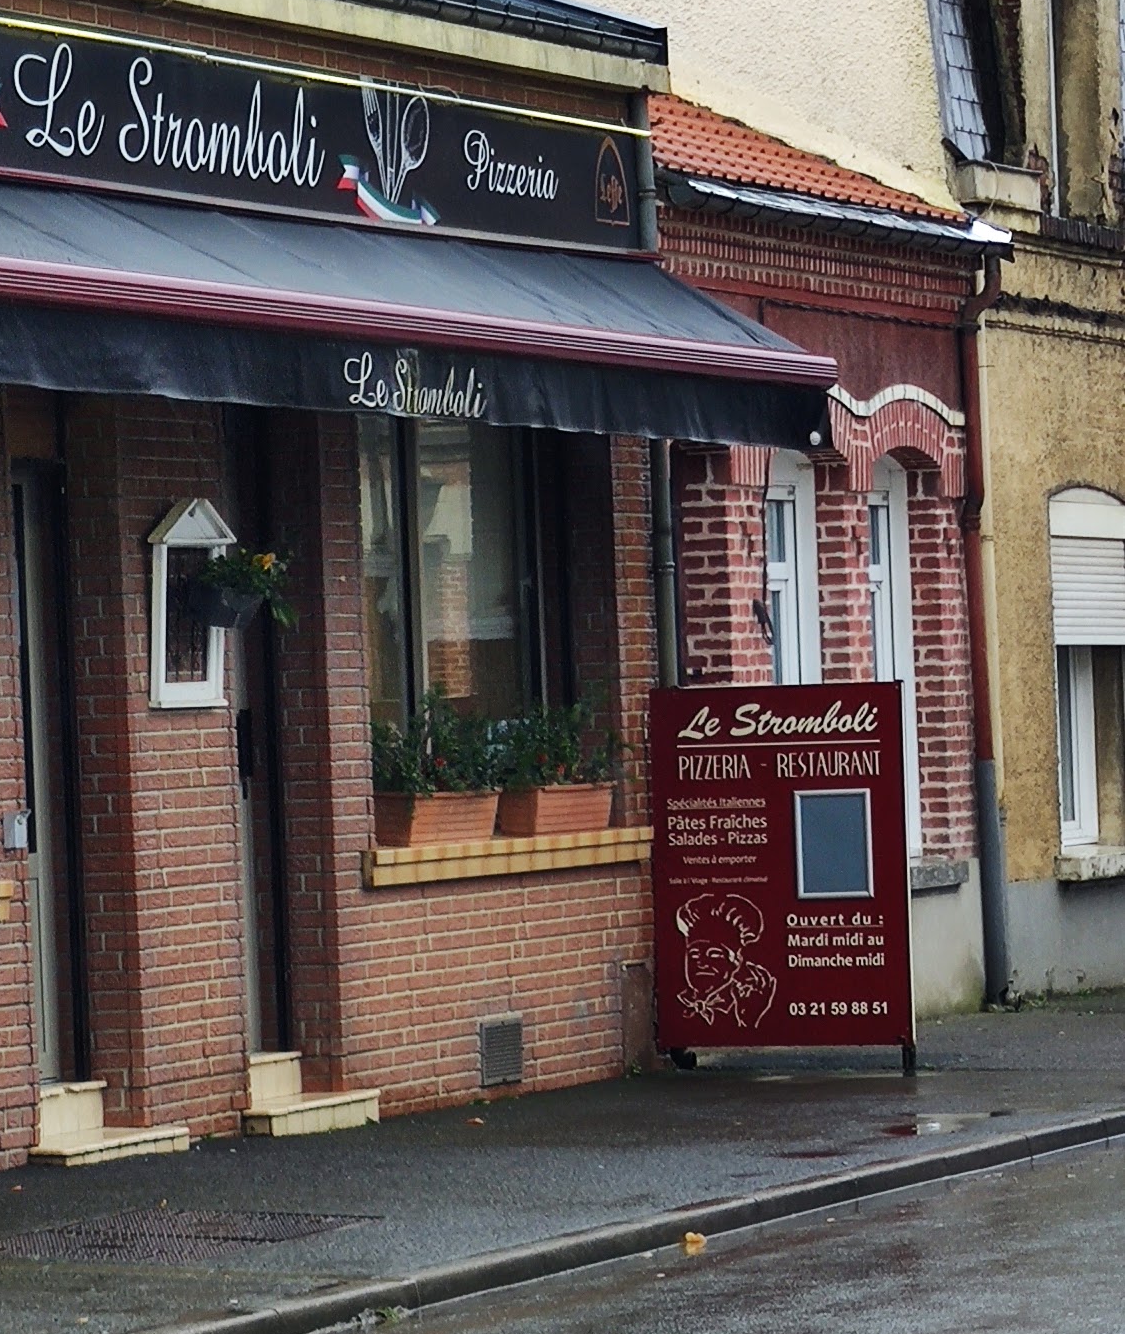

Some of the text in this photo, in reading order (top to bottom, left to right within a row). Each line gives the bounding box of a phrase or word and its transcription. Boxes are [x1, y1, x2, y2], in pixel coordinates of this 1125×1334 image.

[13, 43, 325, 188] Le Stromboli
[464, 129, 559, 200] Pizzeria
[344, 352, 488, 418] Le Stromboli
[677, 700, 878, 740] Le Stromboli
[678, 754, 752, 780] PIZZERIA
[777, 750, 881, 779] RESTAURANT
[667, 813, 768, 830] Pâtes Fraîches
[668, 831, 718, 846] Salades
[727, 830, 768, 845] Pizzas
[786, 913, 845, 926] Ouvert
[851, 911, 871, 925] du
[787, 932, 884, 947] Mardi midi au
[788, 952, 885, 968] Dimanche midi
[789, 1001, 888, 1016] 03 21 59 88 51
